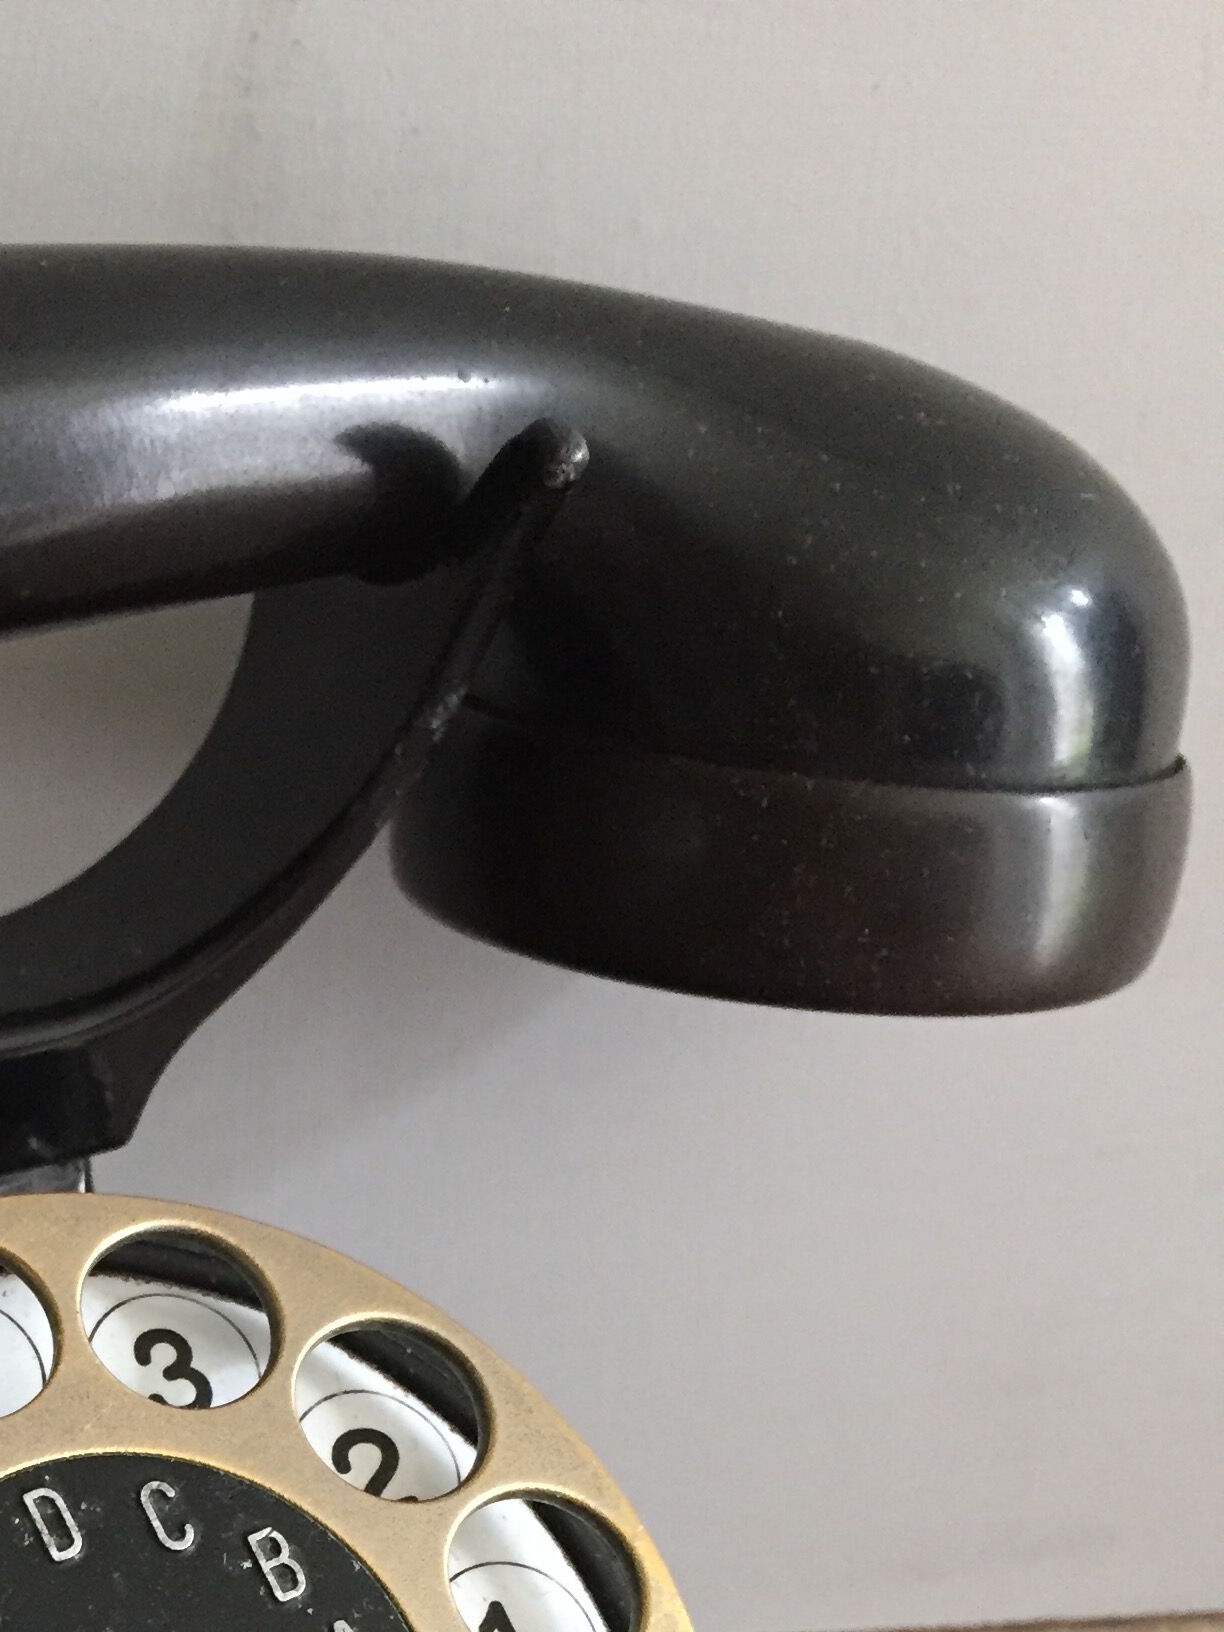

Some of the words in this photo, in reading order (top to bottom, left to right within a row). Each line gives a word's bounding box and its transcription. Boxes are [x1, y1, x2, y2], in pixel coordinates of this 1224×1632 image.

[133, 1328, 213, 1410] 3
[331, 1427, 419, 1501] 2
[23, 1487, 83, 1562] D
[140, 1481, 195, 1550] C
[247, 1527, 307, 1602] B
